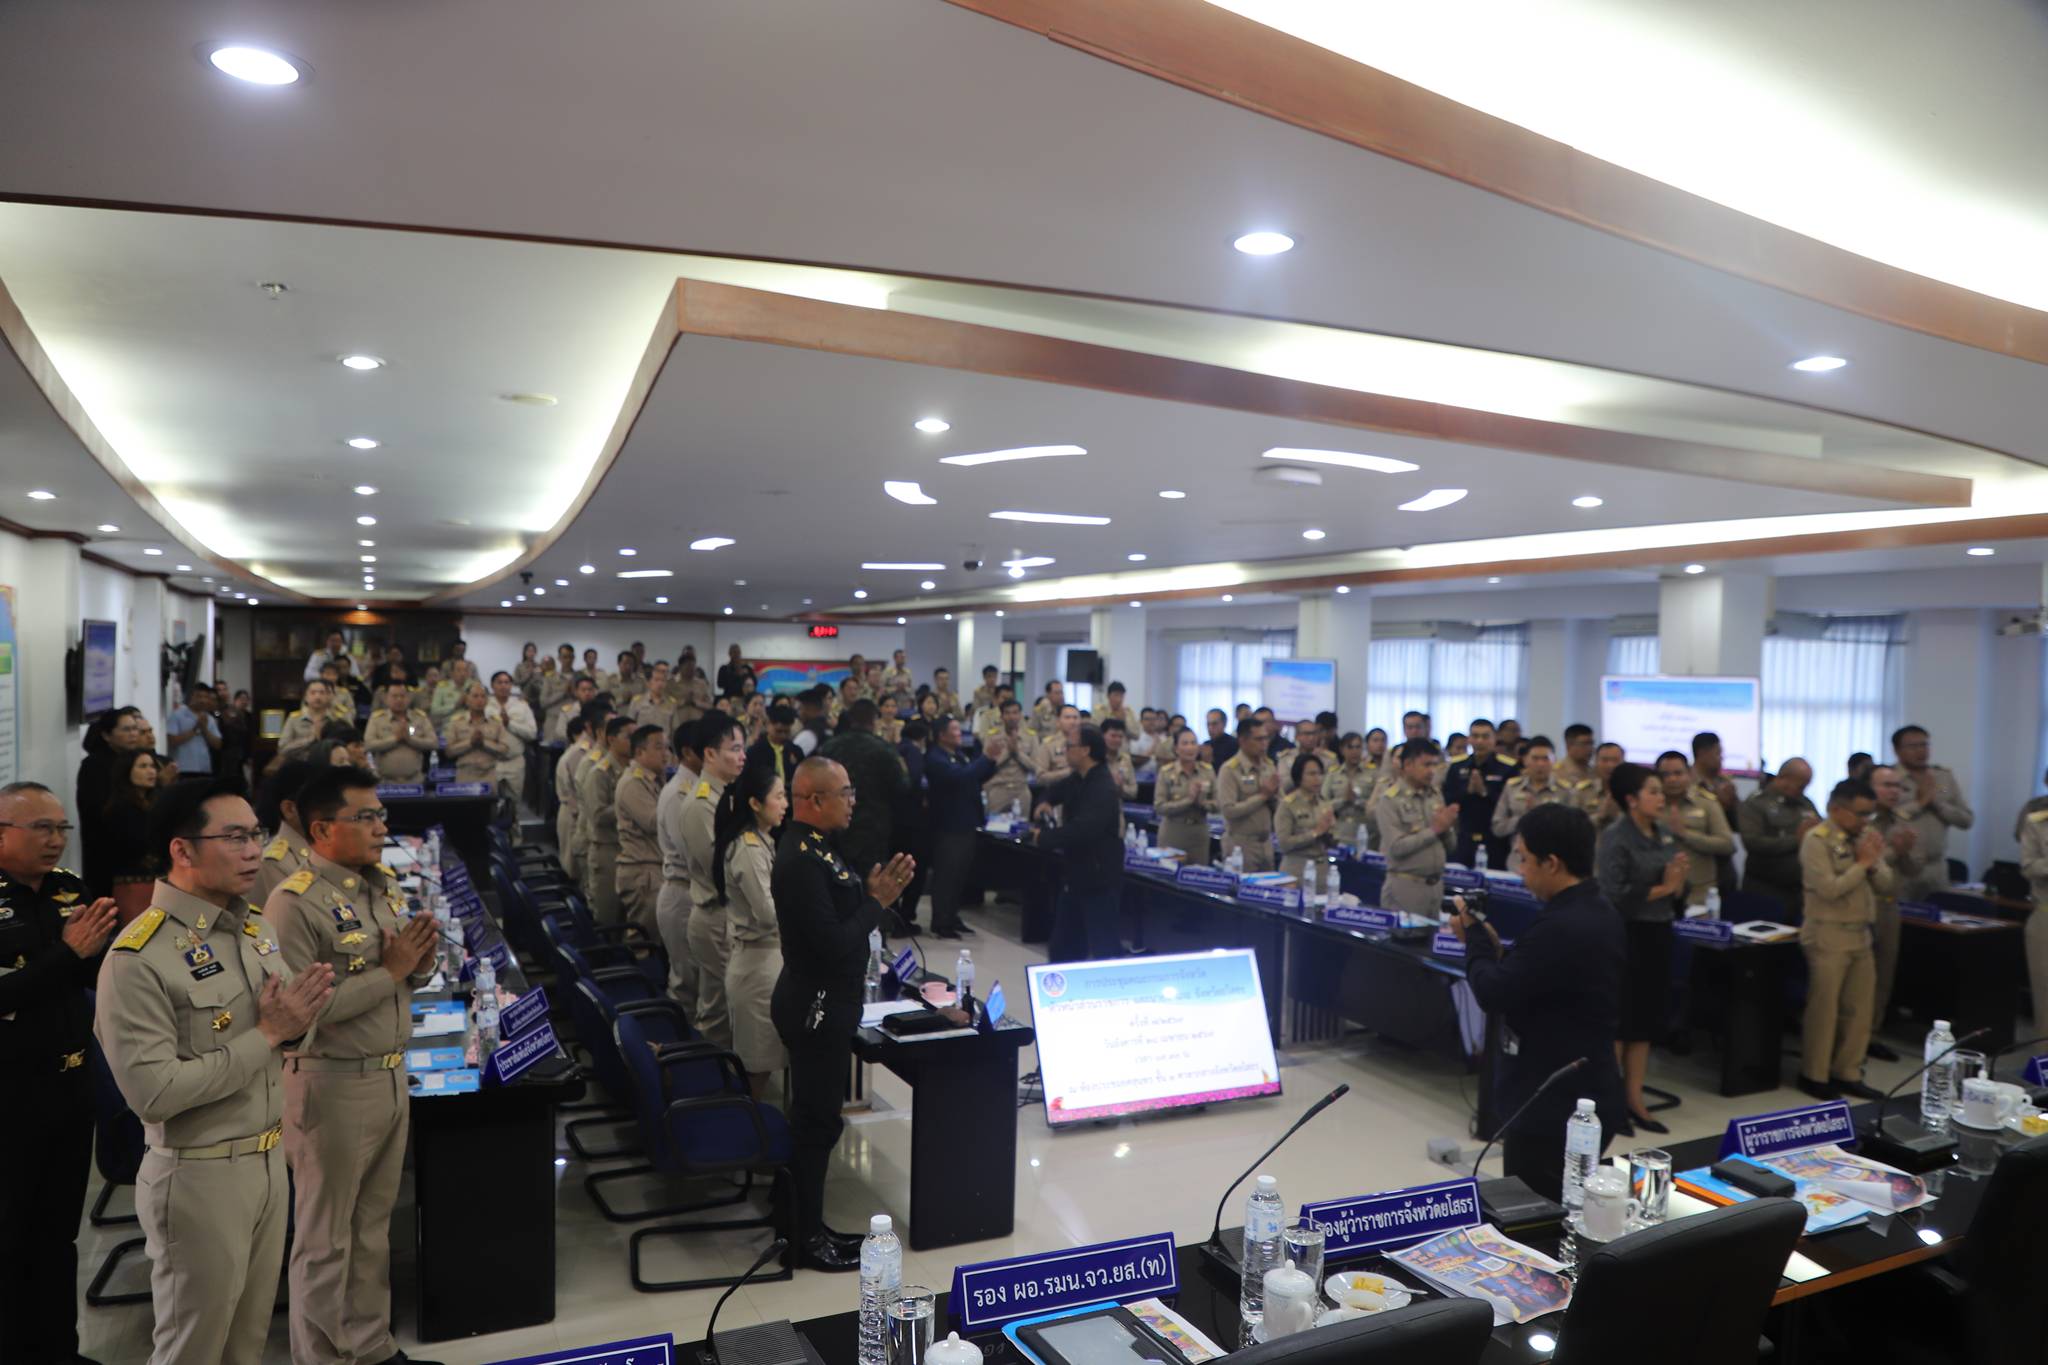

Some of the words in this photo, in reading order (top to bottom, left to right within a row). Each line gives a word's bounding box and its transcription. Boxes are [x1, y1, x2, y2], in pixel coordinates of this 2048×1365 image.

[973, 1286, 1007, 1307] รอง
[1013, 1254, 1167, 1300] ผอ.รมน.จว.ยส.(ท)
